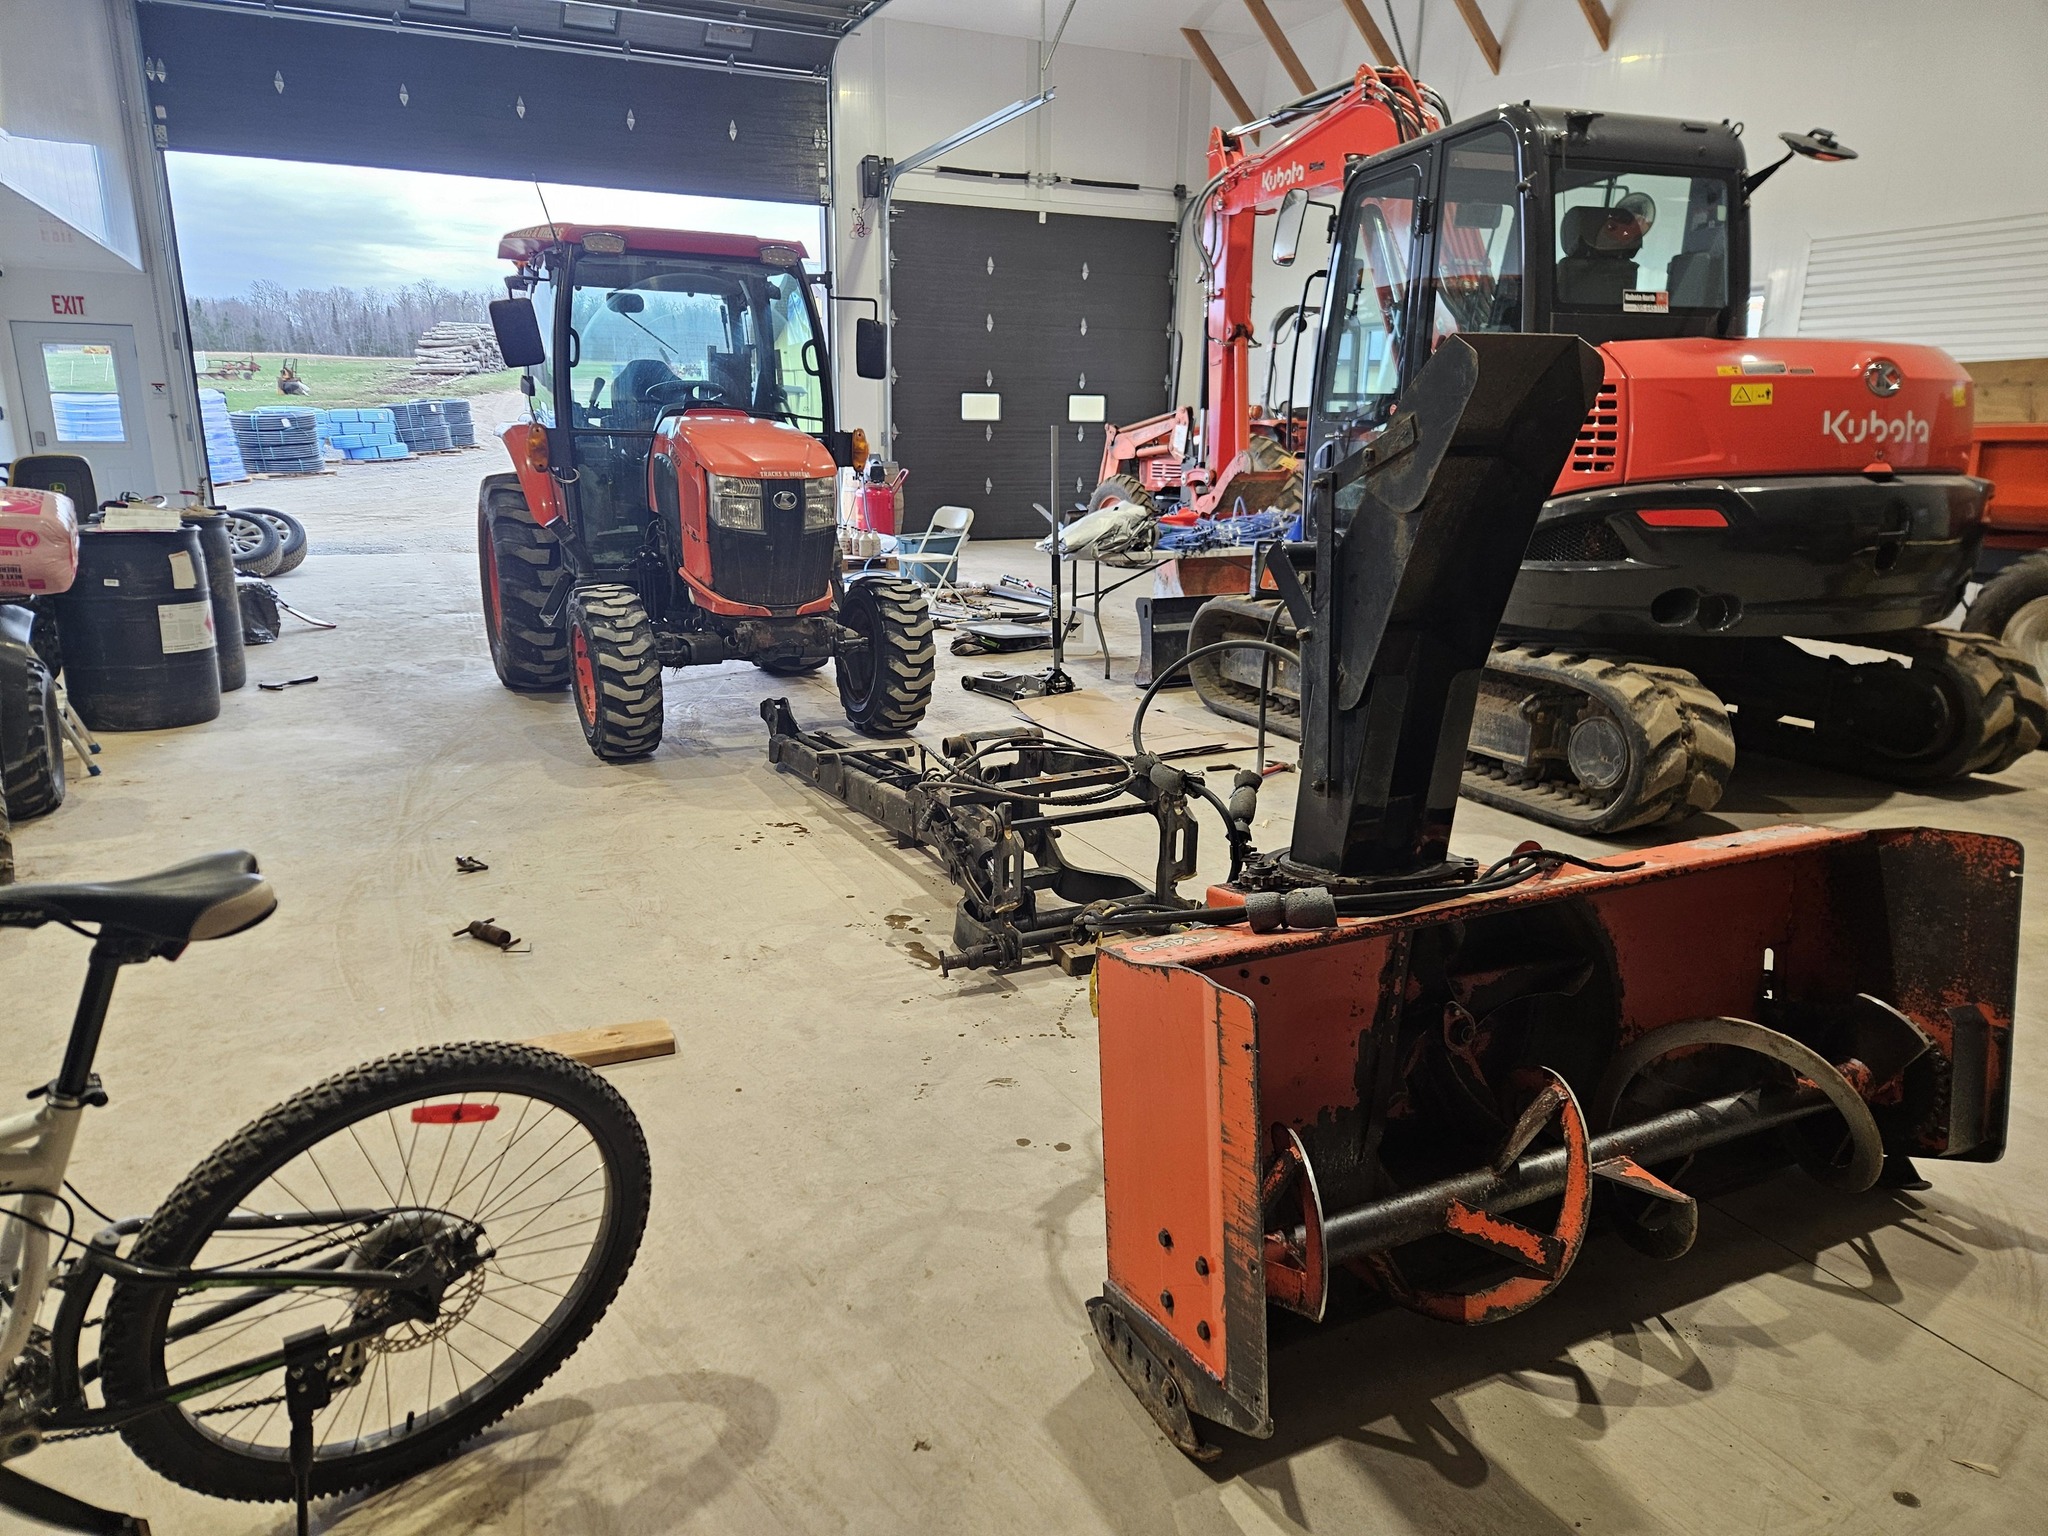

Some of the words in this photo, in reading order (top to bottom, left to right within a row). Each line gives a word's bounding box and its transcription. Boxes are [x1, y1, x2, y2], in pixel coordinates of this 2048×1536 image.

[1262, 161, 1304, 192] Kubota
[51, 295, 84, 315] EXIT
[1823, 410, 1929, 444] Kubota
